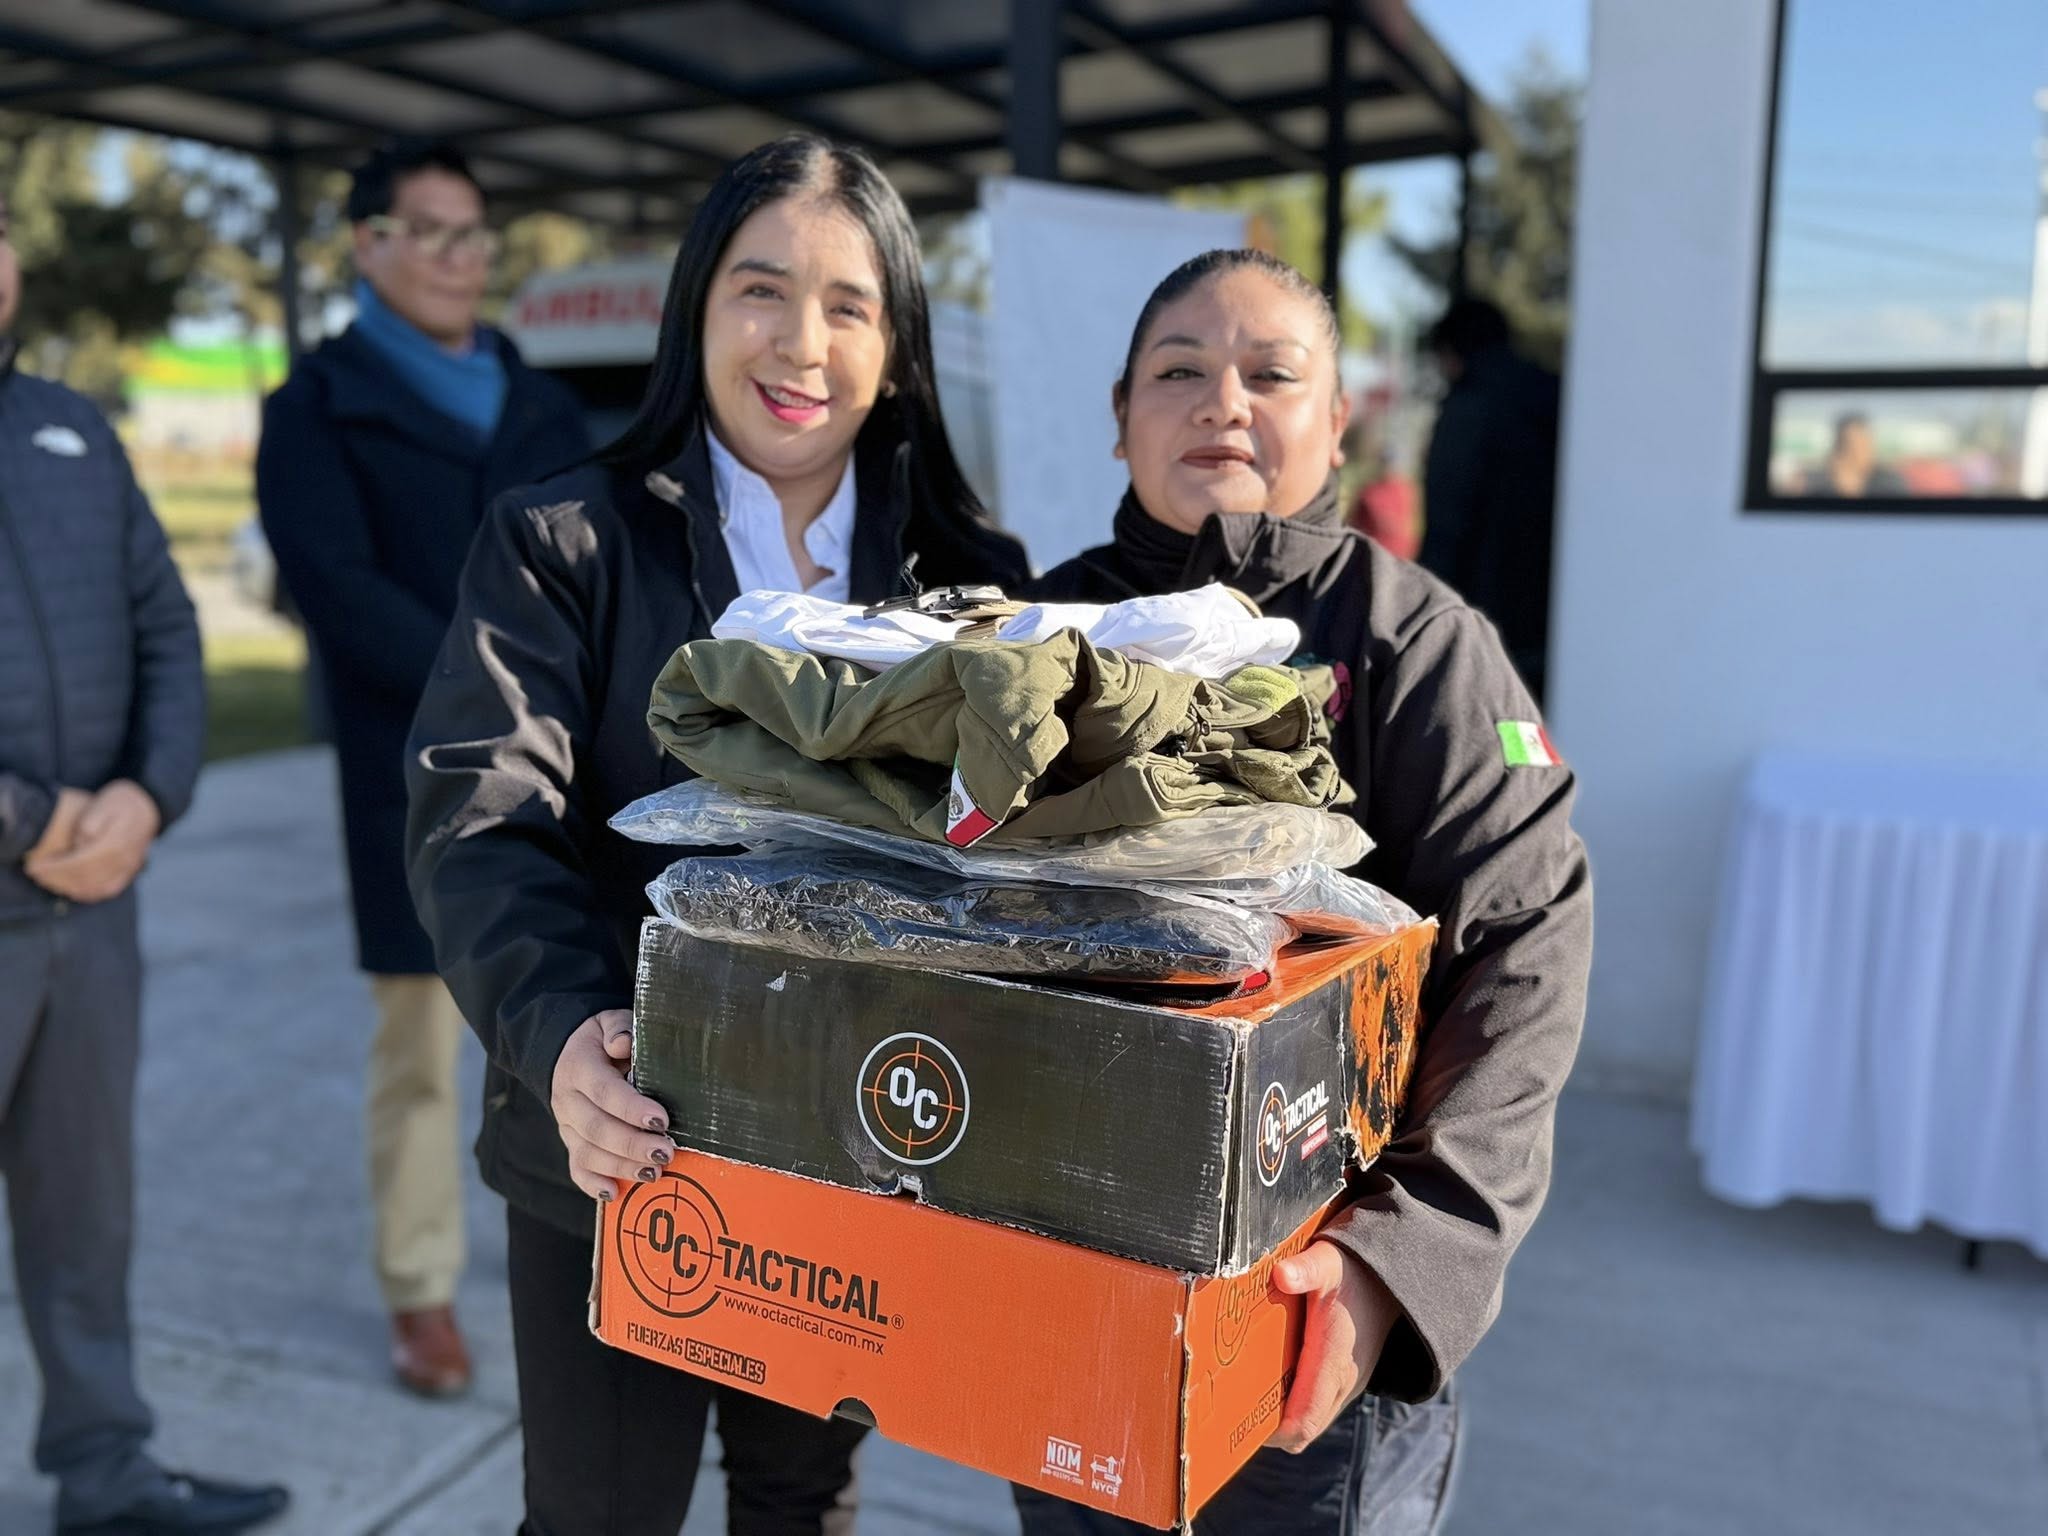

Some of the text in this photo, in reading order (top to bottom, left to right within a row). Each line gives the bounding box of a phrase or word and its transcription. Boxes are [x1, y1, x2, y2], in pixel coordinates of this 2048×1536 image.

[889, 1066, 939, 1130] OC
[1283, 1080, 1330, 1135] TACTICAL
[648, 1208, 888, 1325] OC TACTICAL
[627, 1321, 766, 1385] FUERZAS ESPECIALES
[724, 1294, 885, 1355] www.octactical.com.mx
[1046, 1440, 1082, 1472] NOM
[1091, 1480, 1120, 1497] NYCE
